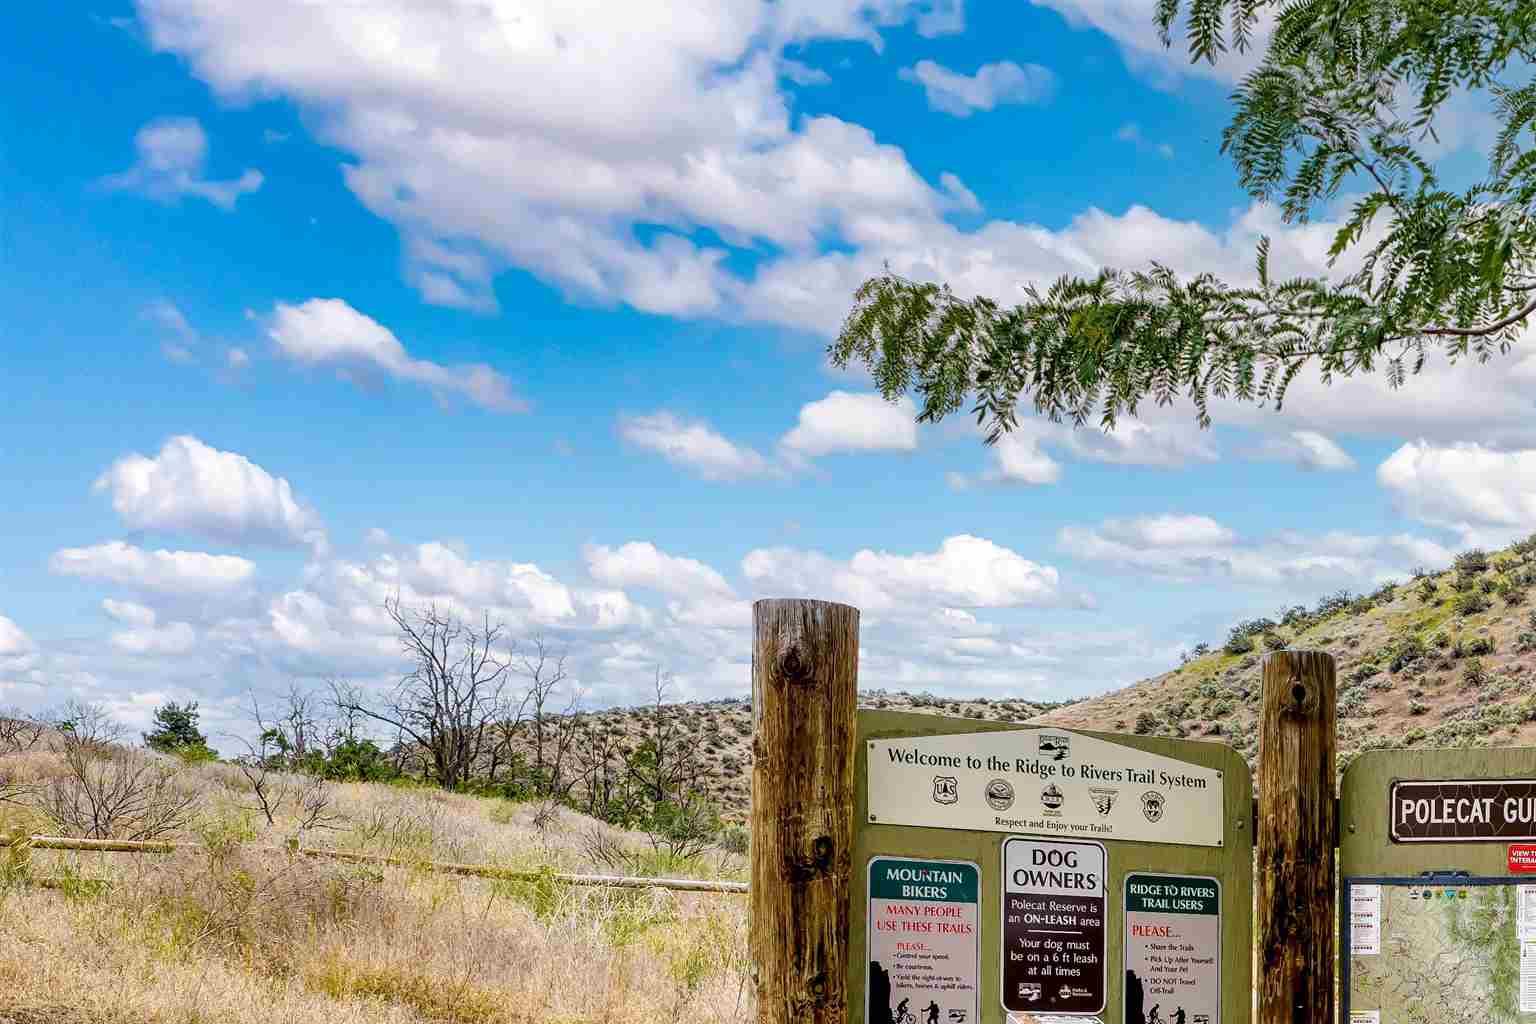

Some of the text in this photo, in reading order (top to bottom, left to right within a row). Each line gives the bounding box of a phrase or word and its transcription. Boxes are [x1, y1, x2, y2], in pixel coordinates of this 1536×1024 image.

[888, 748, 1208, 789] Welcome to the Ridge to Rivers Trail System
[1401, 798, 1494, 824] POLECAT
[995, 816, 1027, 830] Respect
[1029, 819, 1044, 829] and
[1046, 820, 1070, 832] Enjoy
[1072, 822, 1088, 833] your
[1032, 848, 1078, 868] DOG
[1512, 849, 1530, 857] VIEW
[886, 868, 962, 883] MOUNTAIN
[1013, 869, 1097, 890] OWNERS
[902, 885, 948, 899] BIKERS
[1130, 884, 1215, 898] RIDGE TO RIVERS
[886, 905, 961, 918] MANY PEOPLE
[1011, 899, 1097, 913] Polecat Reserve is
[1142, 898, 1203, 911] TRAIL USERS
[876, 920, 972, 934] USE THESE TRAILS
[1008, 913, 1100, 927] an ON-LEASH area
[1019, 938, 1090, 952] Your dog must
[1010, 950, 1098, 964] be on a 6 ft leash
[1028, 965, 1080, 976] at all times
